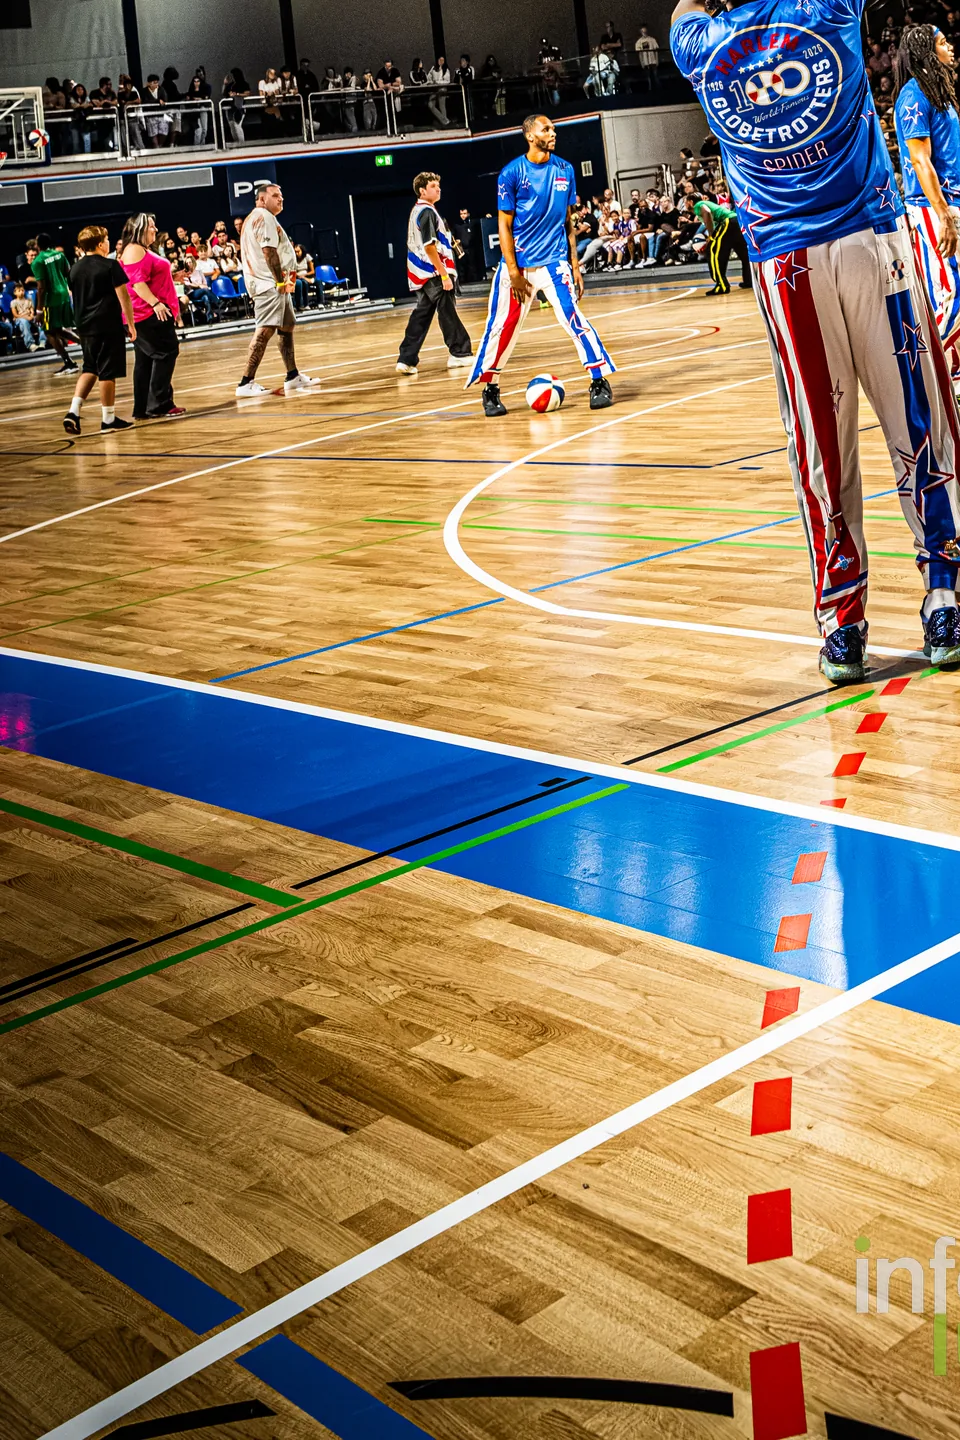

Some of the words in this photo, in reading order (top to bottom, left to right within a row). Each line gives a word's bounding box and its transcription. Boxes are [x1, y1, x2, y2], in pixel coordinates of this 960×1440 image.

[715, 32, 800, 76] HARLEM
[802, 43, 824, 60] 2026
[706, 82, 724, 93] 1926
[712, 58, 834, 144] GLOBETROTTERS
[762, 140, 829, 172] SPIDER
